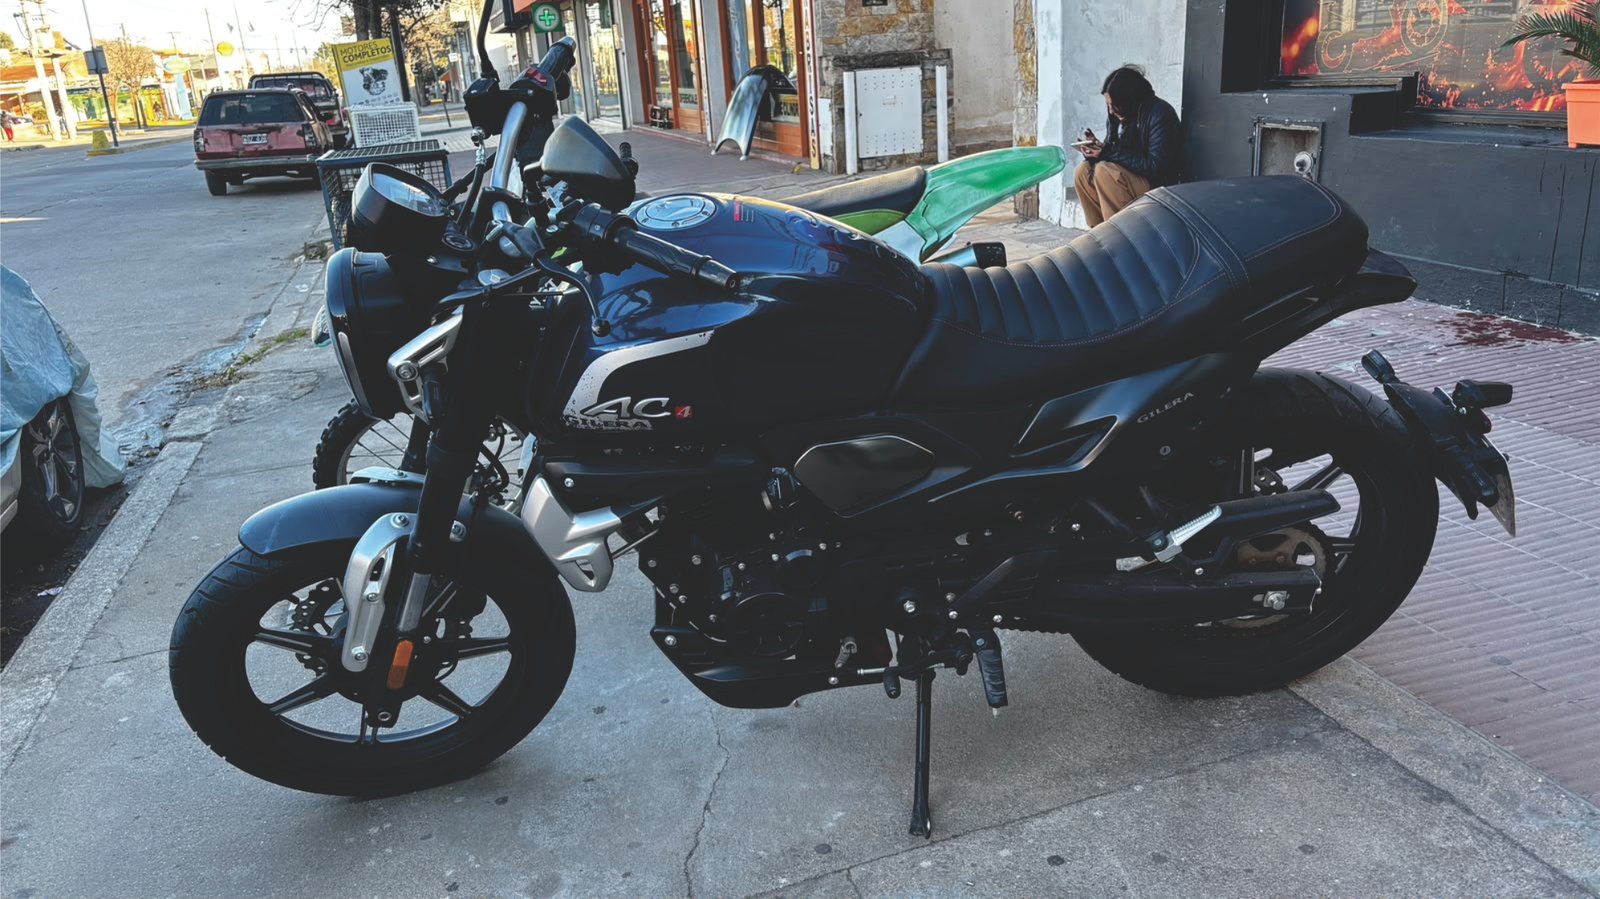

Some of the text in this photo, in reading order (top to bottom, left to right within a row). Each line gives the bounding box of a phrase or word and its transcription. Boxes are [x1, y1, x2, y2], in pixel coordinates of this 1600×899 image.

[340, 41, 378, 56] MOTORES
[343, 46, 391, 63] COMPLETOS
[582, 396, 691, 418] AC 4
[1137, 392, 1194, 423] GILERA
